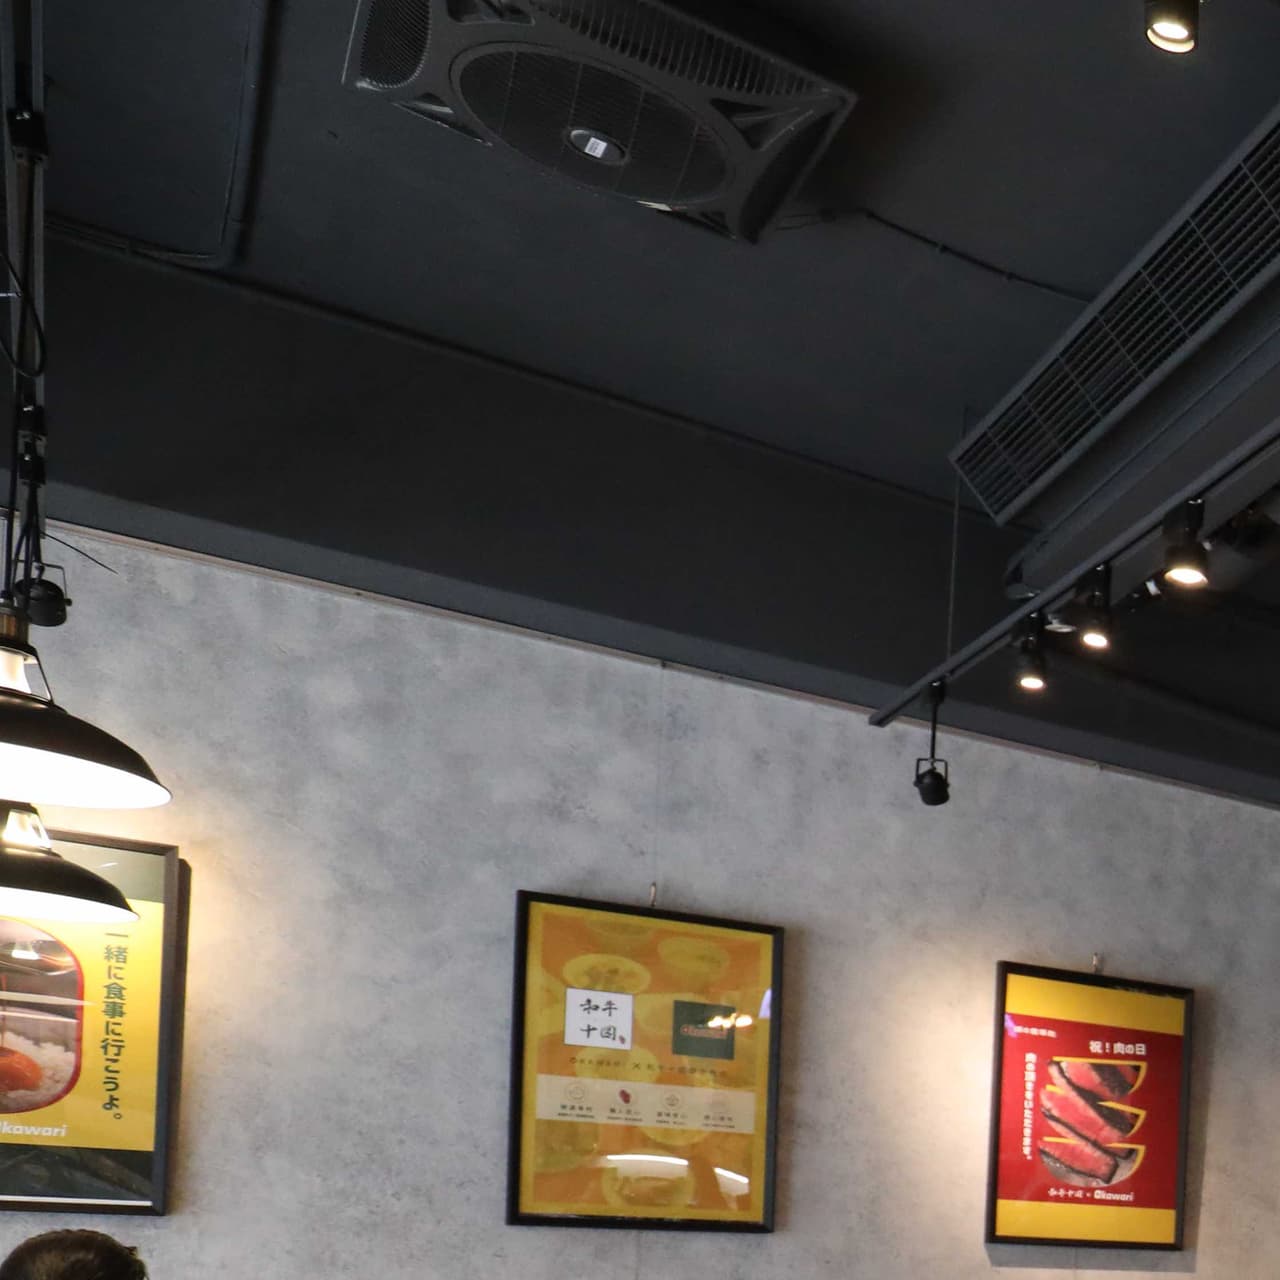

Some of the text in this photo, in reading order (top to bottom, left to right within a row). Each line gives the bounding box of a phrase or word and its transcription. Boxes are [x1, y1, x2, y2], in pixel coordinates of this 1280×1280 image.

[100, 932, 129, 1120] 一緒に食事に行こうよ。
[0, 1120, 67, 1138] kawari
